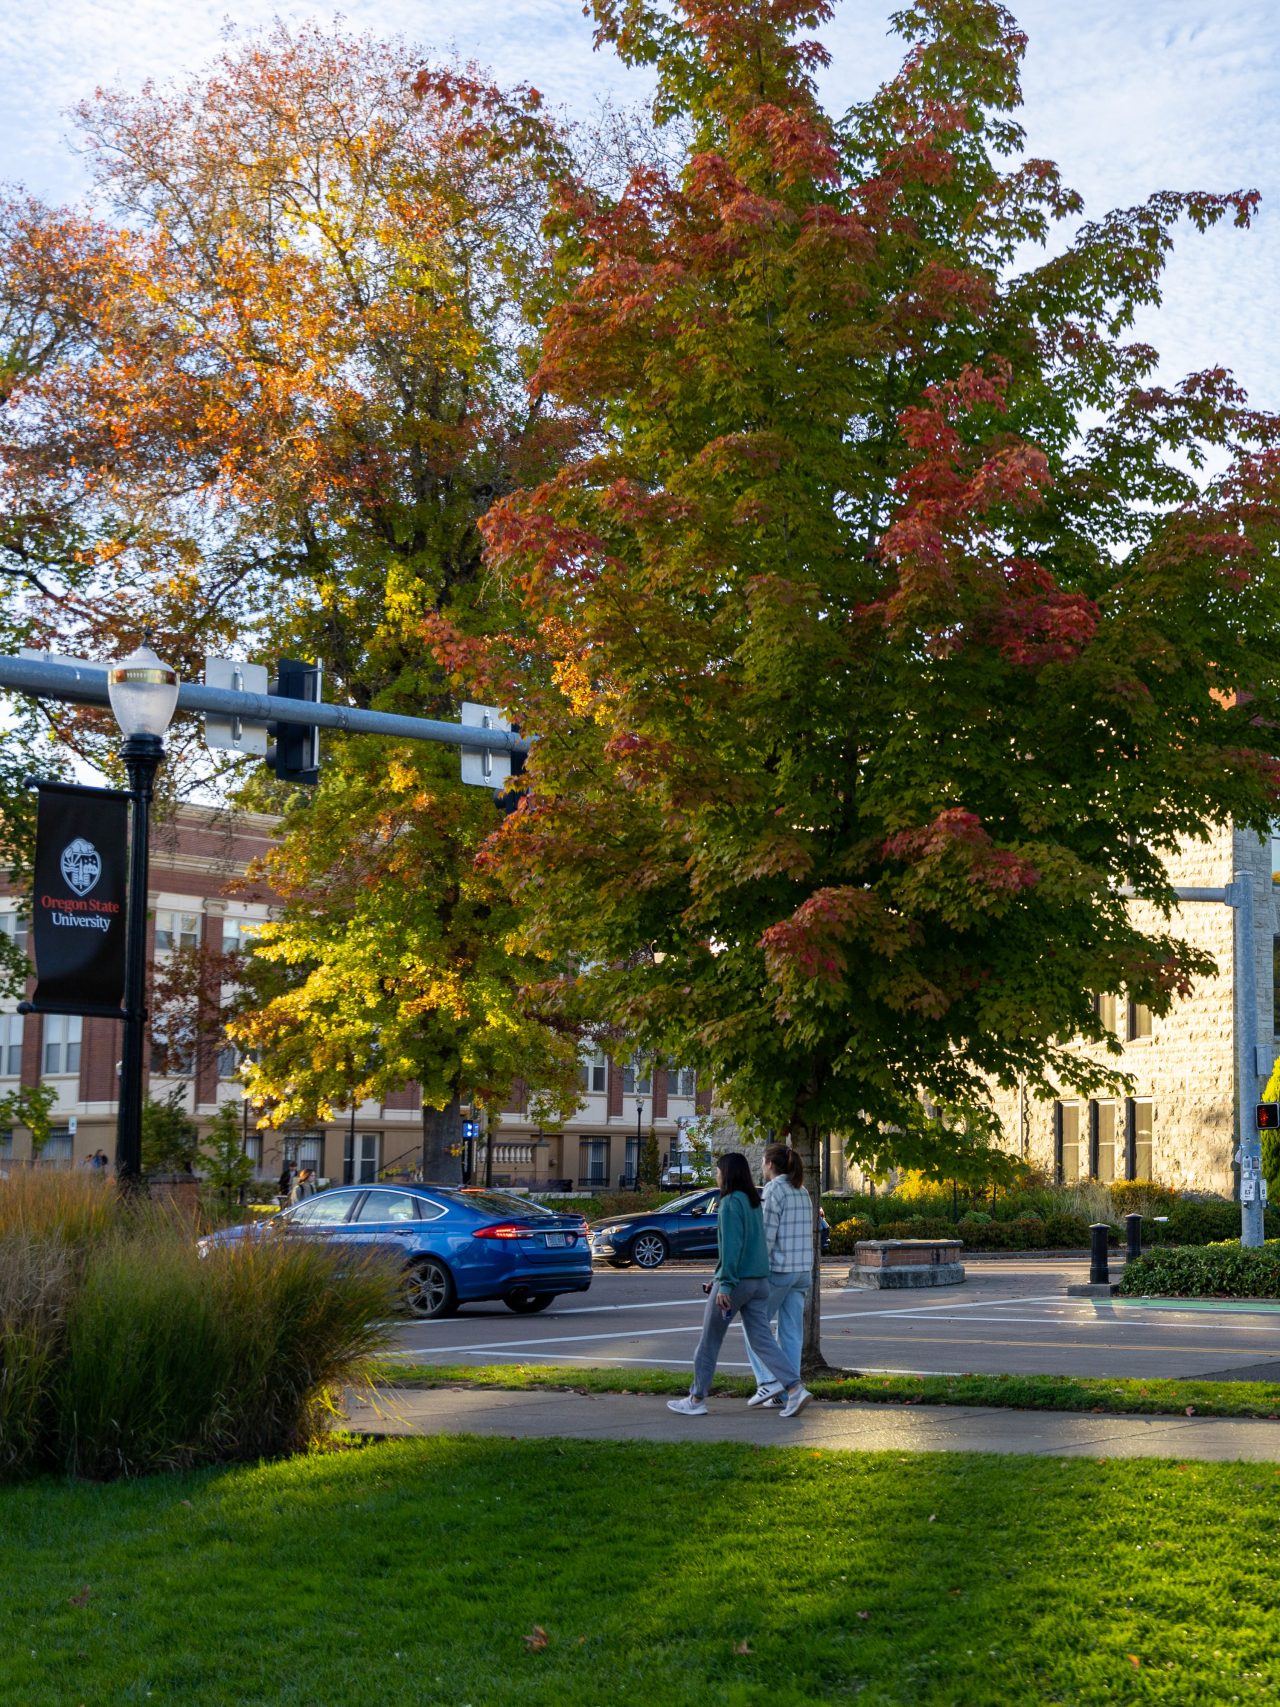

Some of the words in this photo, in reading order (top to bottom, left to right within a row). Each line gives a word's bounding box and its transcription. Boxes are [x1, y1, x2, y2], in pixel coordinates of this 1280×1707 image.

[41, 895, 87, 912] Oregon
[89, 899, 120, 913] State
[51, 912, 111, 932] University
